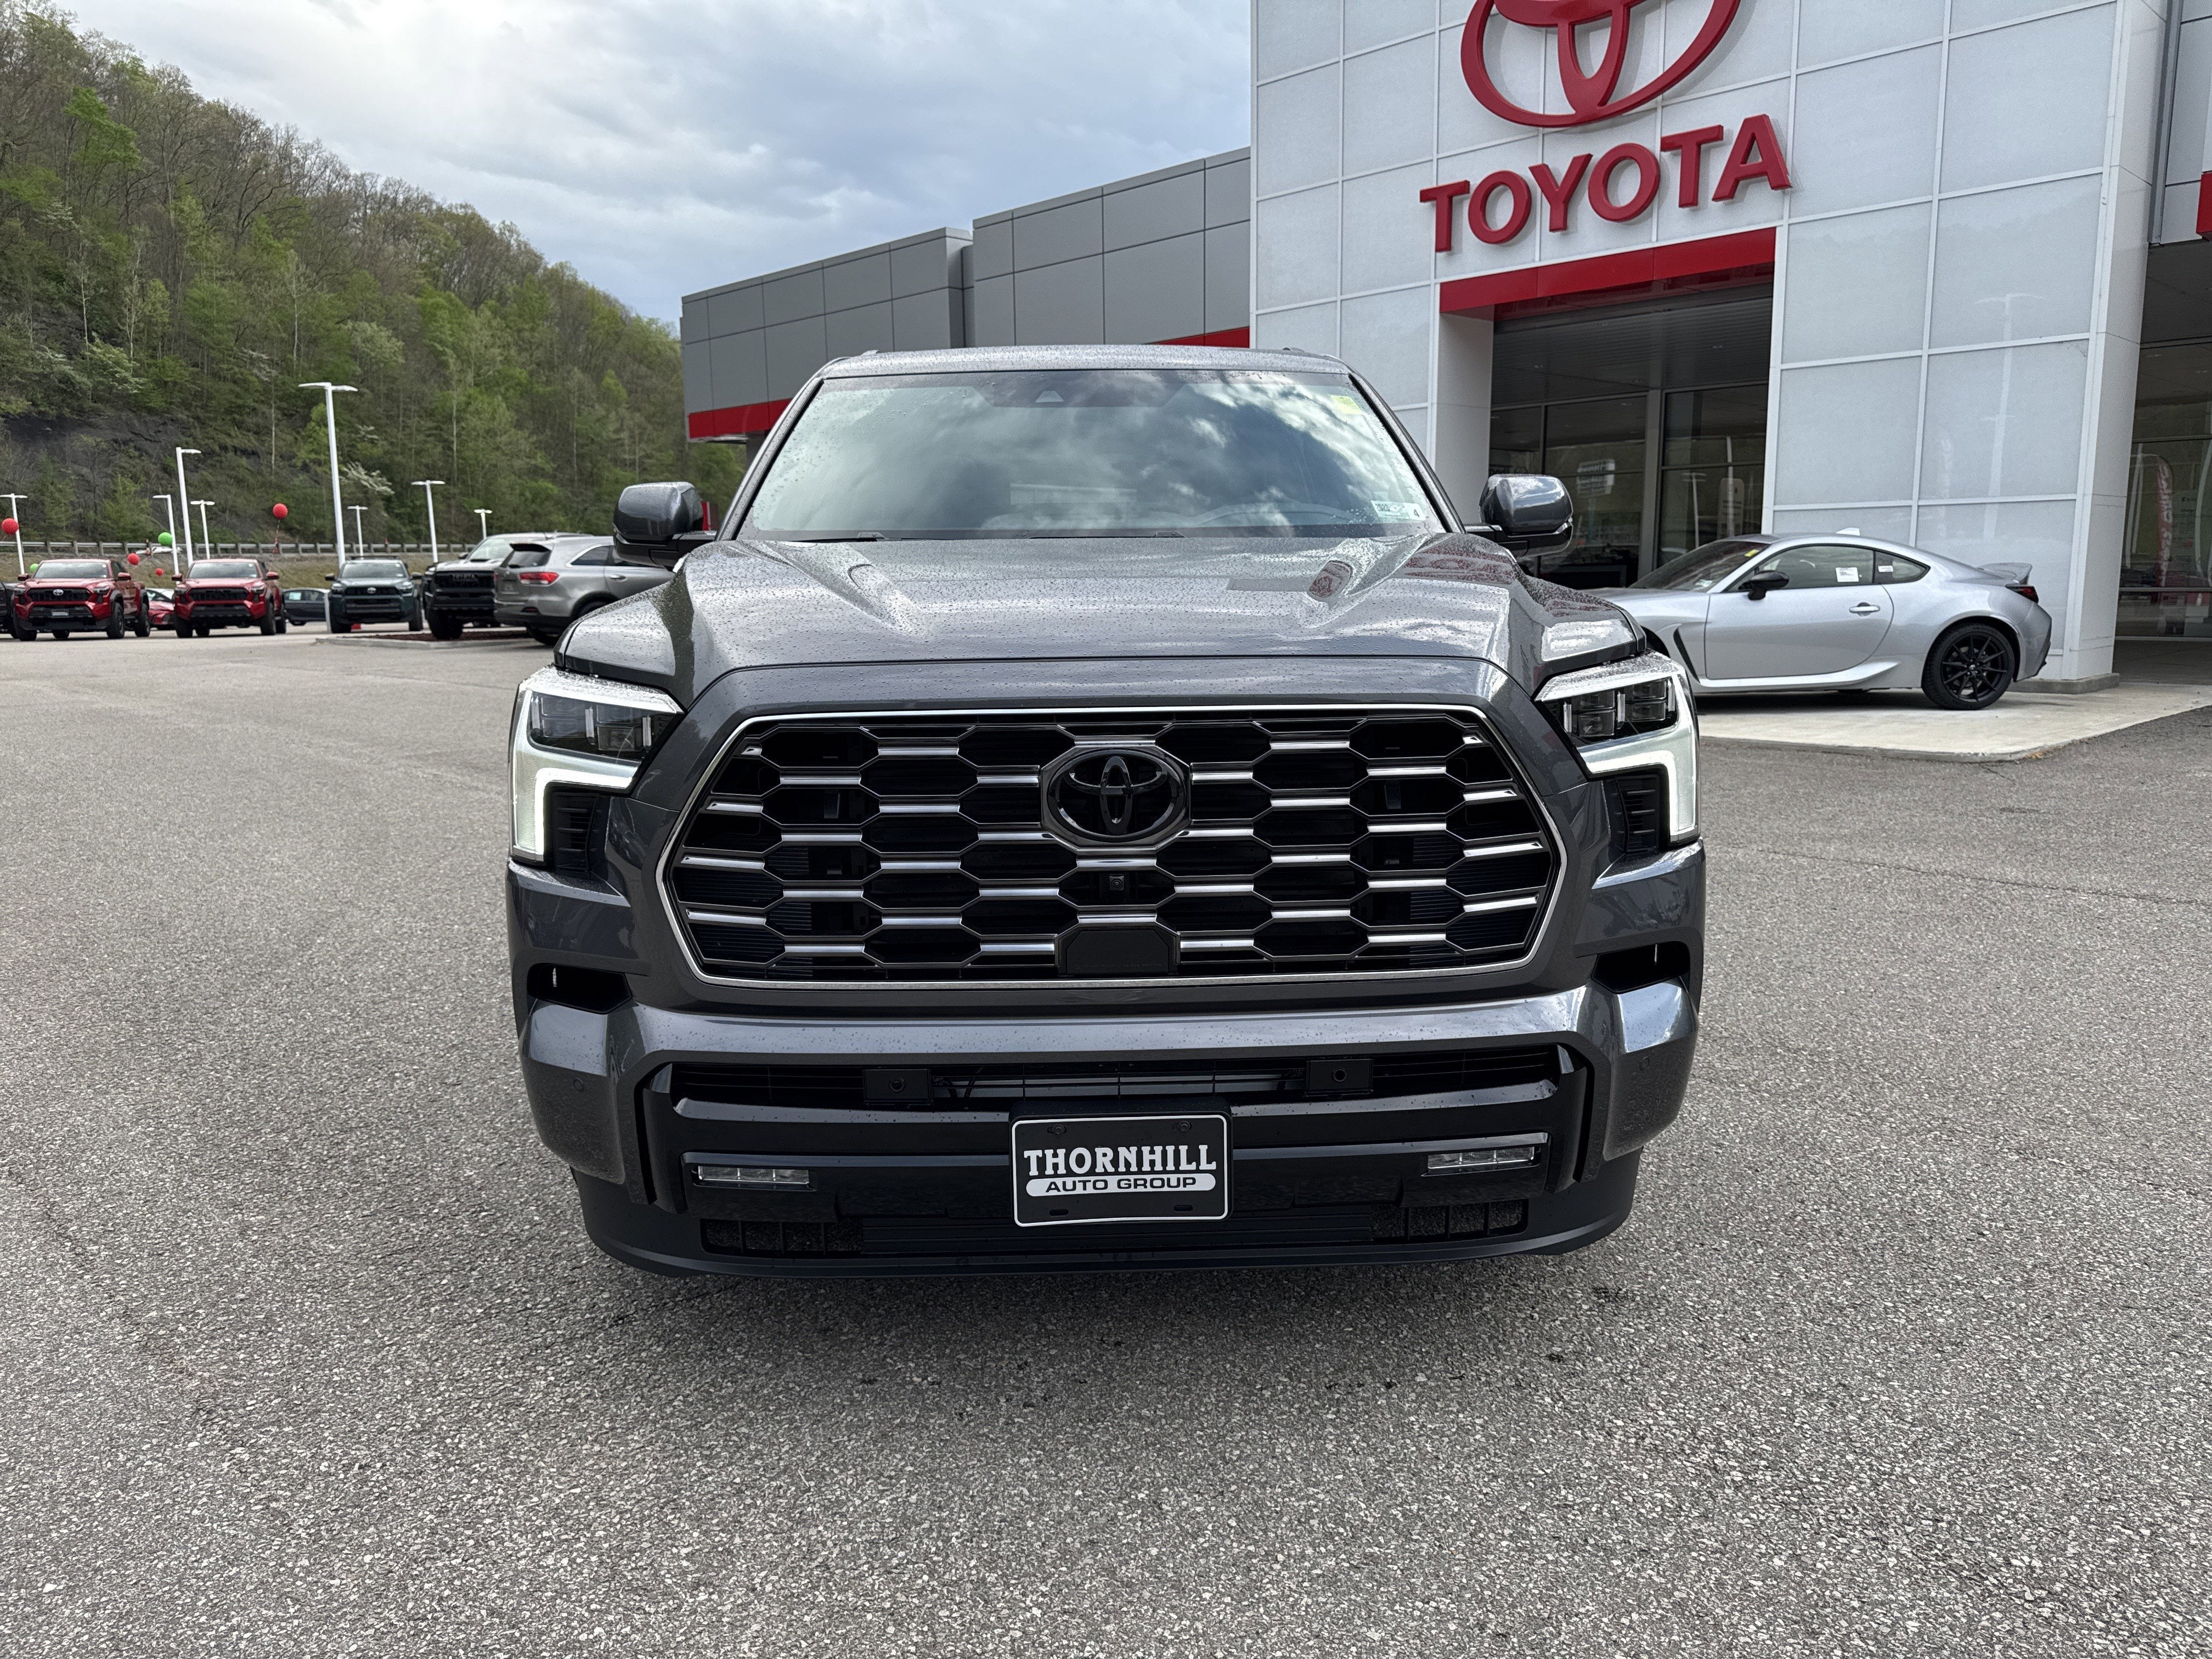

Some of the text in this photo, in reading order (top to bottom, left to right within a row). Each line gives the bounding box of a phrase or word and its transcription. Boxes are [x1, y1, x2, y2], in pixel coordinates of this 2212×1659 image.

[1419, 114, 1792, 253] TOYOTA
[1023, 1144, 1217, 1176] THORNHILL
[1045, 1177, 1197, 1193] AUTO GROUP
